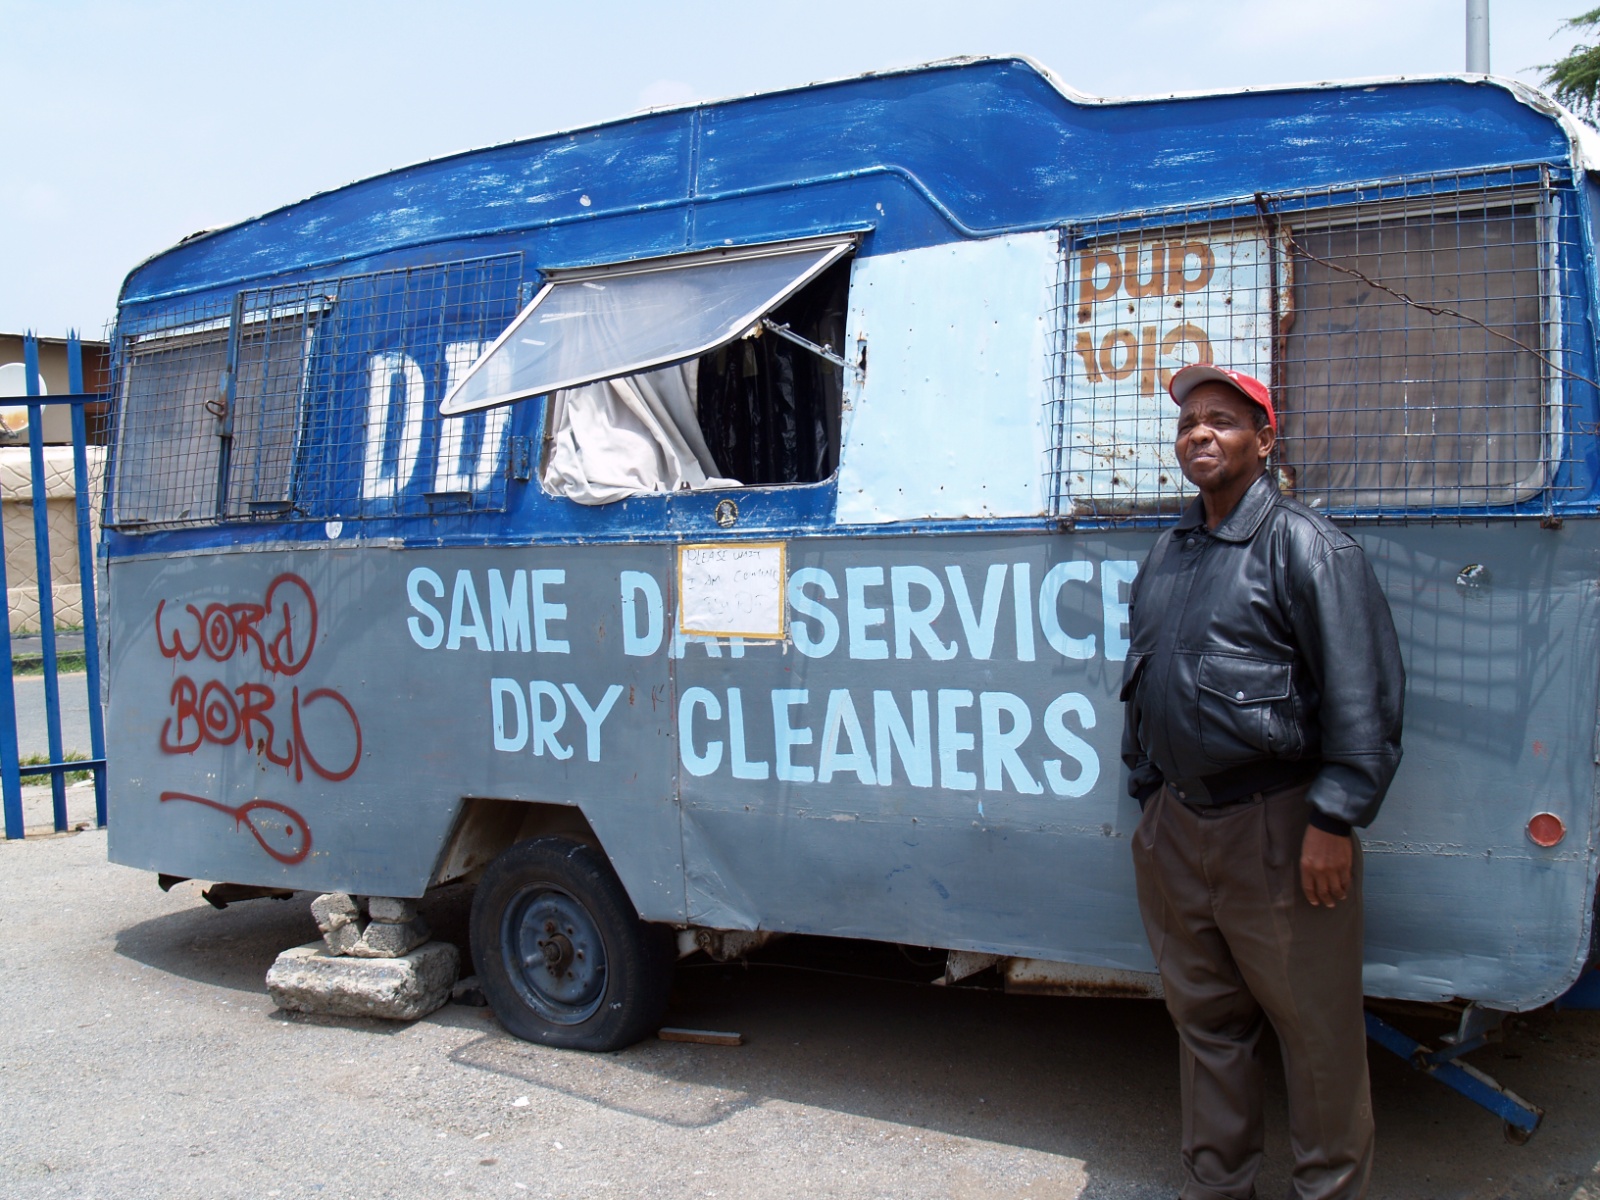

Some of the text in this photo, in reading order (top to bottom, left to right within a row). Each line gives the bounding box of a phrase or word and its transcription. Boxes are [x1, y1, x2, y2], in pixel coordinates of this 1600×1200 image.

[406, 567, 570, 654] SAME
[788, 560, 1138, 661] SERVICE
[491, 678, 1100, 798] DRY CLEANERS
